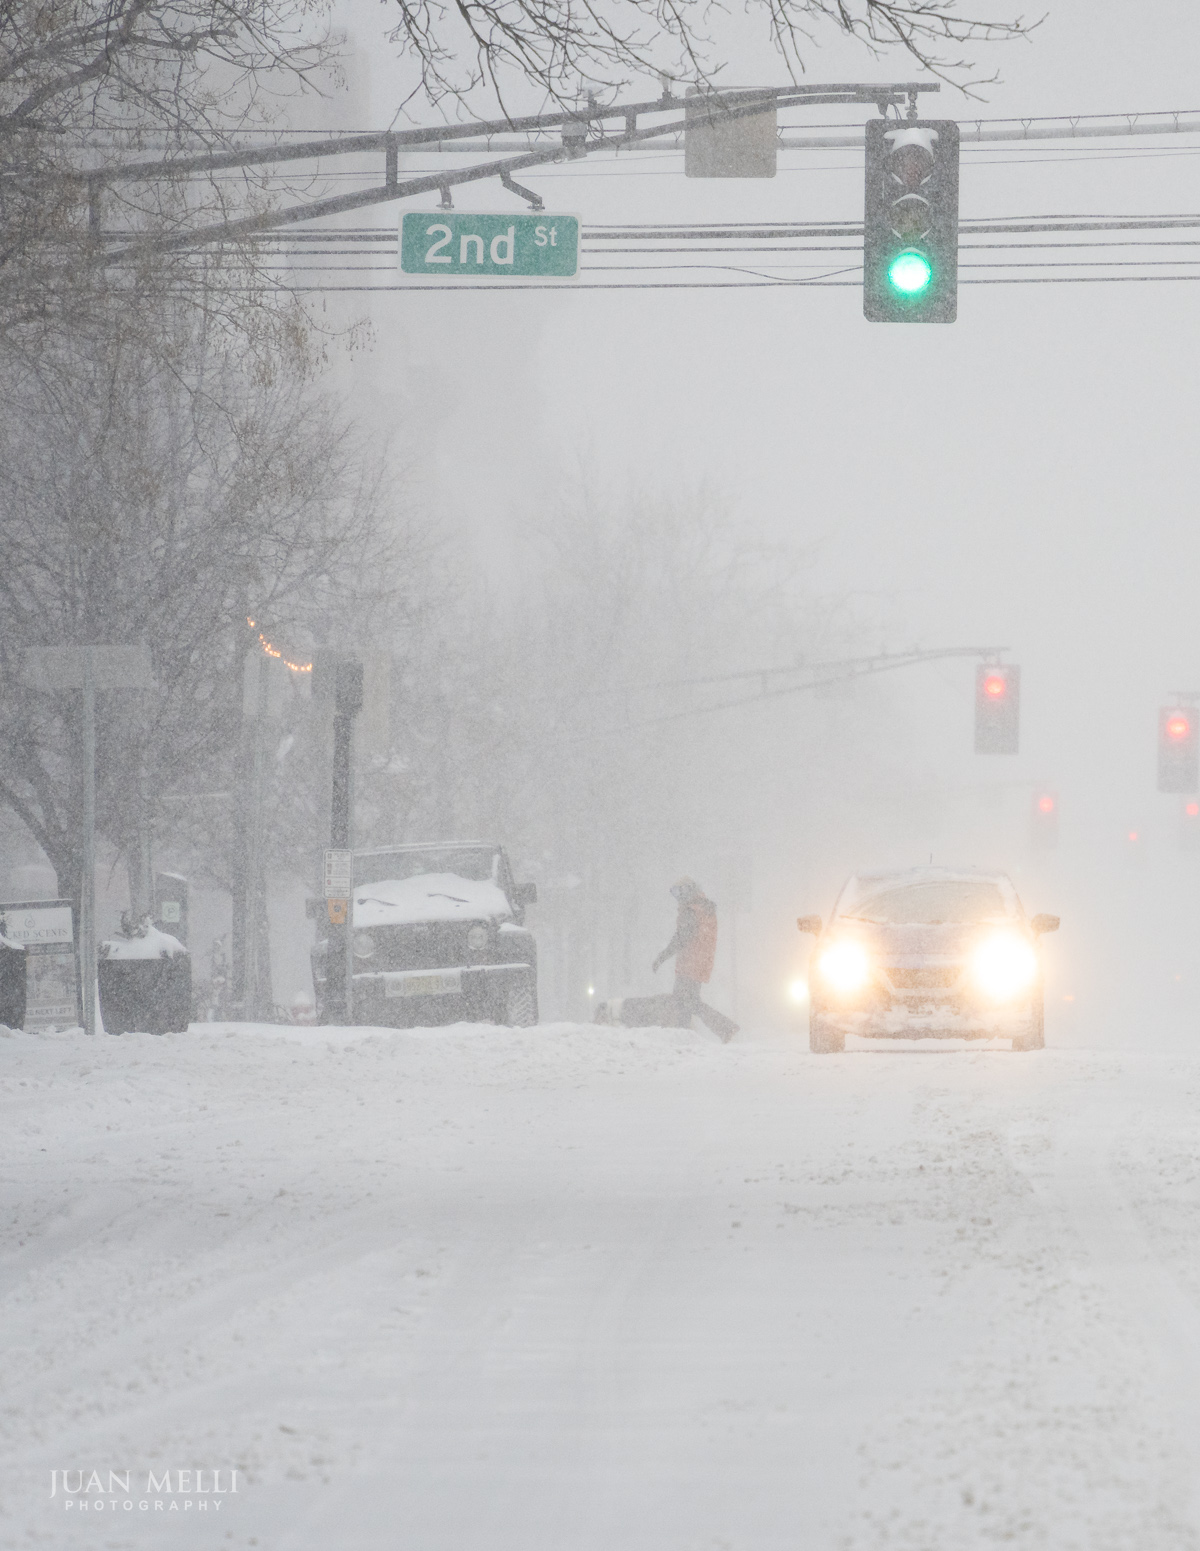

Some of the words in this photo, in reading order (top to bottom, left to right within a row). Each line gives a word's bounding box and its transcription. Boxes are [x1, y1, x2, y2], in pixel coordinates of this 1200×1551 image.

[424, 223, 515, 265] 2nd
[534, 225, 558, 247] St
[33, 928, 68, 938] SCENTS
